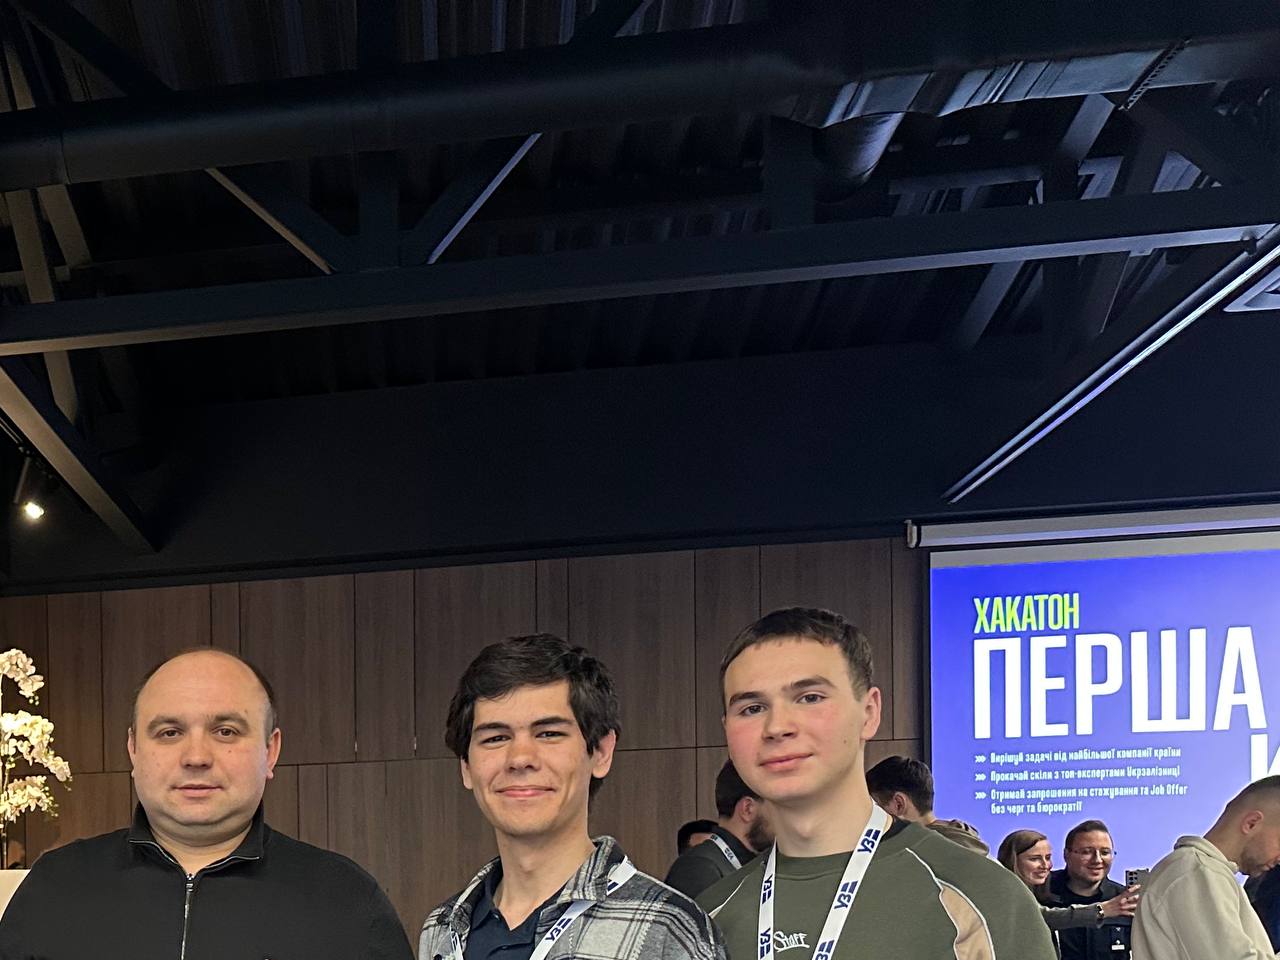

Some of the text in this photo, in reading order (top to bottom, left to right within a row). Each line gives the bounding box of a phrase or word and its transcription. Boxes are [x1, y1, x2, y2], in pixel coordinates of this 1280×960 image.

[973, 593, 1080, 633] ХАКАТОН
[973, 626, 1268, 739] ПЕРША
[990, 746, 1181, 766] Вирішуй задачі від найбільшої компанії країни
[990, 770, 1029, 785] Прокачай
[1030, 769, 1053, 780] скіли
[1126, 765, 1180, 779] Укрзалізниці
[990, 784, 1188, 802] Отримай запрошення на стажування та Job Offer
[991, 801, 1083, 816] без черг та бюрократії
